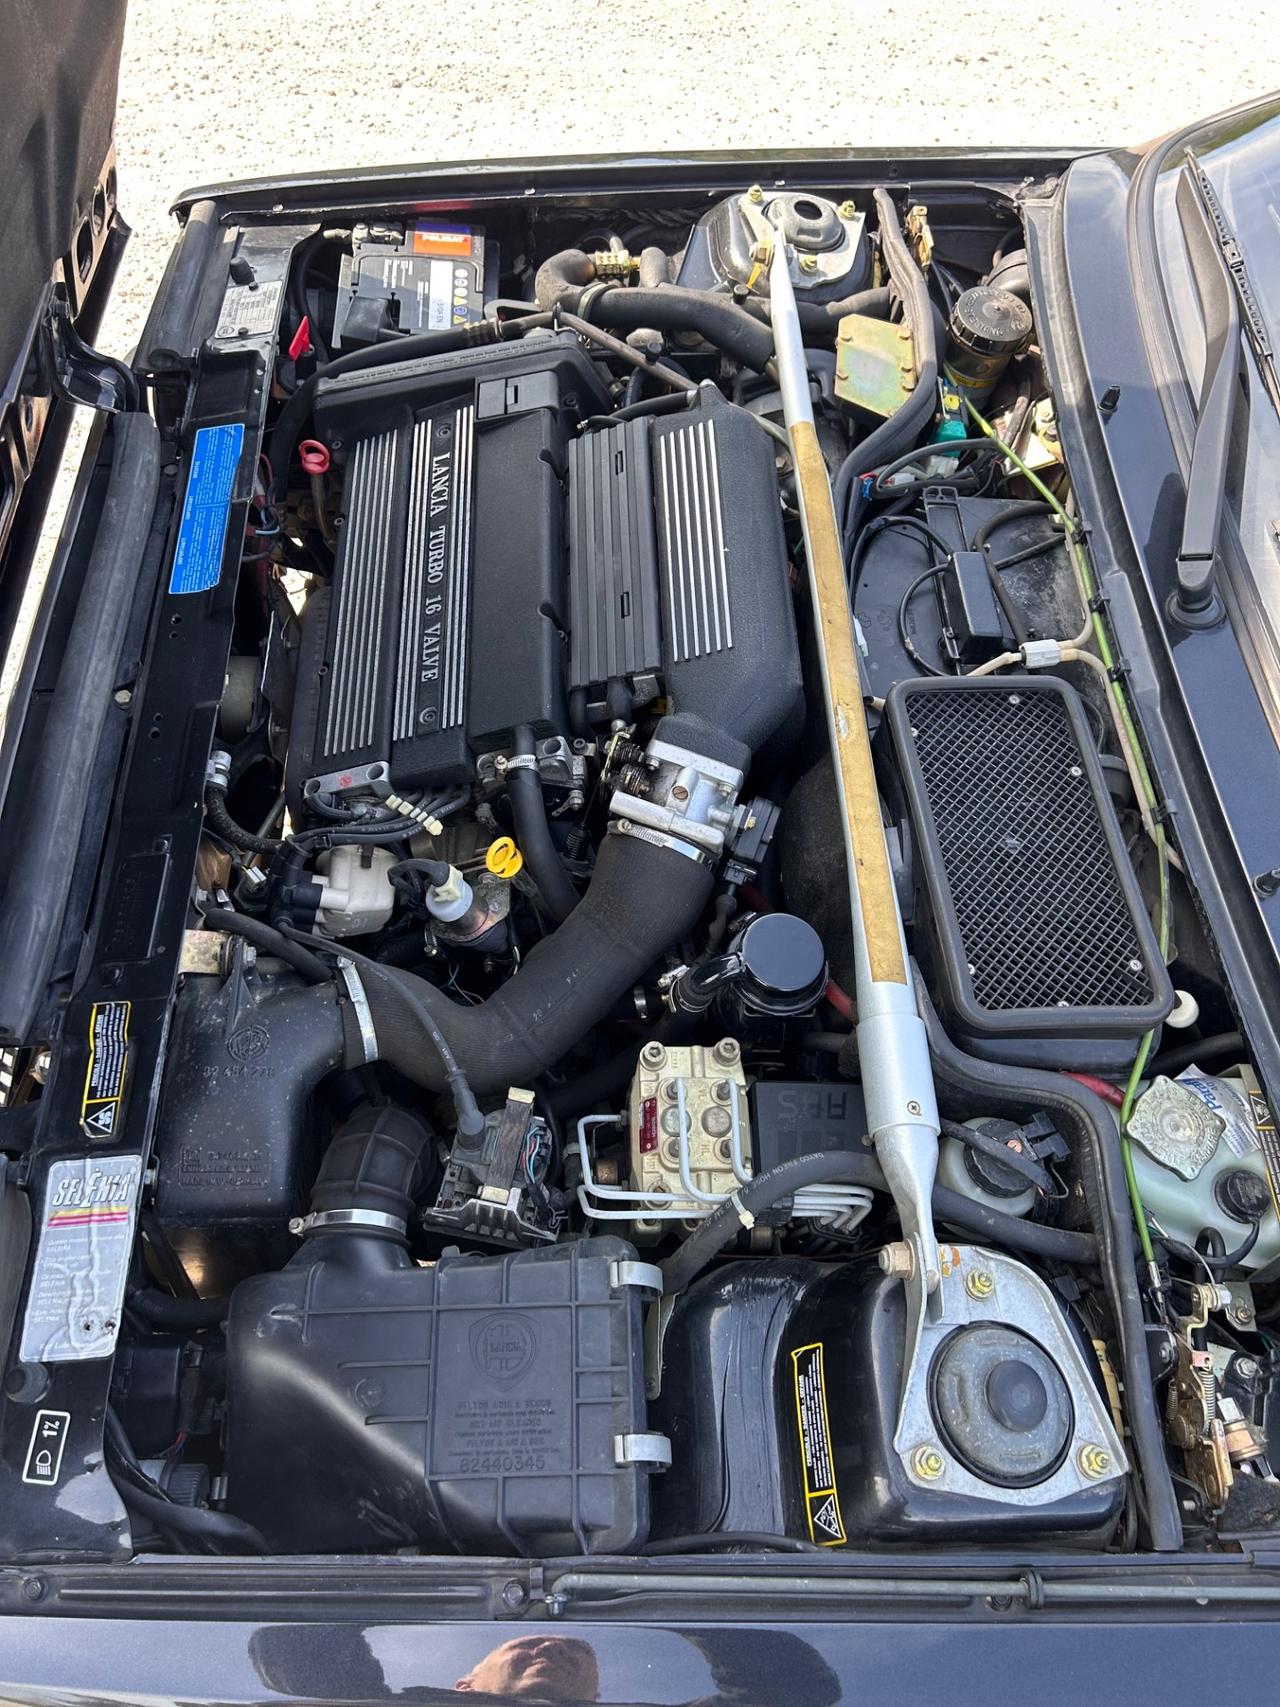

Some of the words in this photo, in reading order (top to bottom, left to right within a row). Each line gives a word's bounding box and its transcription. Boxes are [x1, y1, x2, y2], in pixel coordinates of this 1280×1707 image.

[430, 452, 450, 517] LANCIA
[427, 525, 446, 584] TURBO
[425, 596, 442, 615] 16
[422, 622, 441, 682] VALVE
[42, 1420, 60, 1438] 1%
